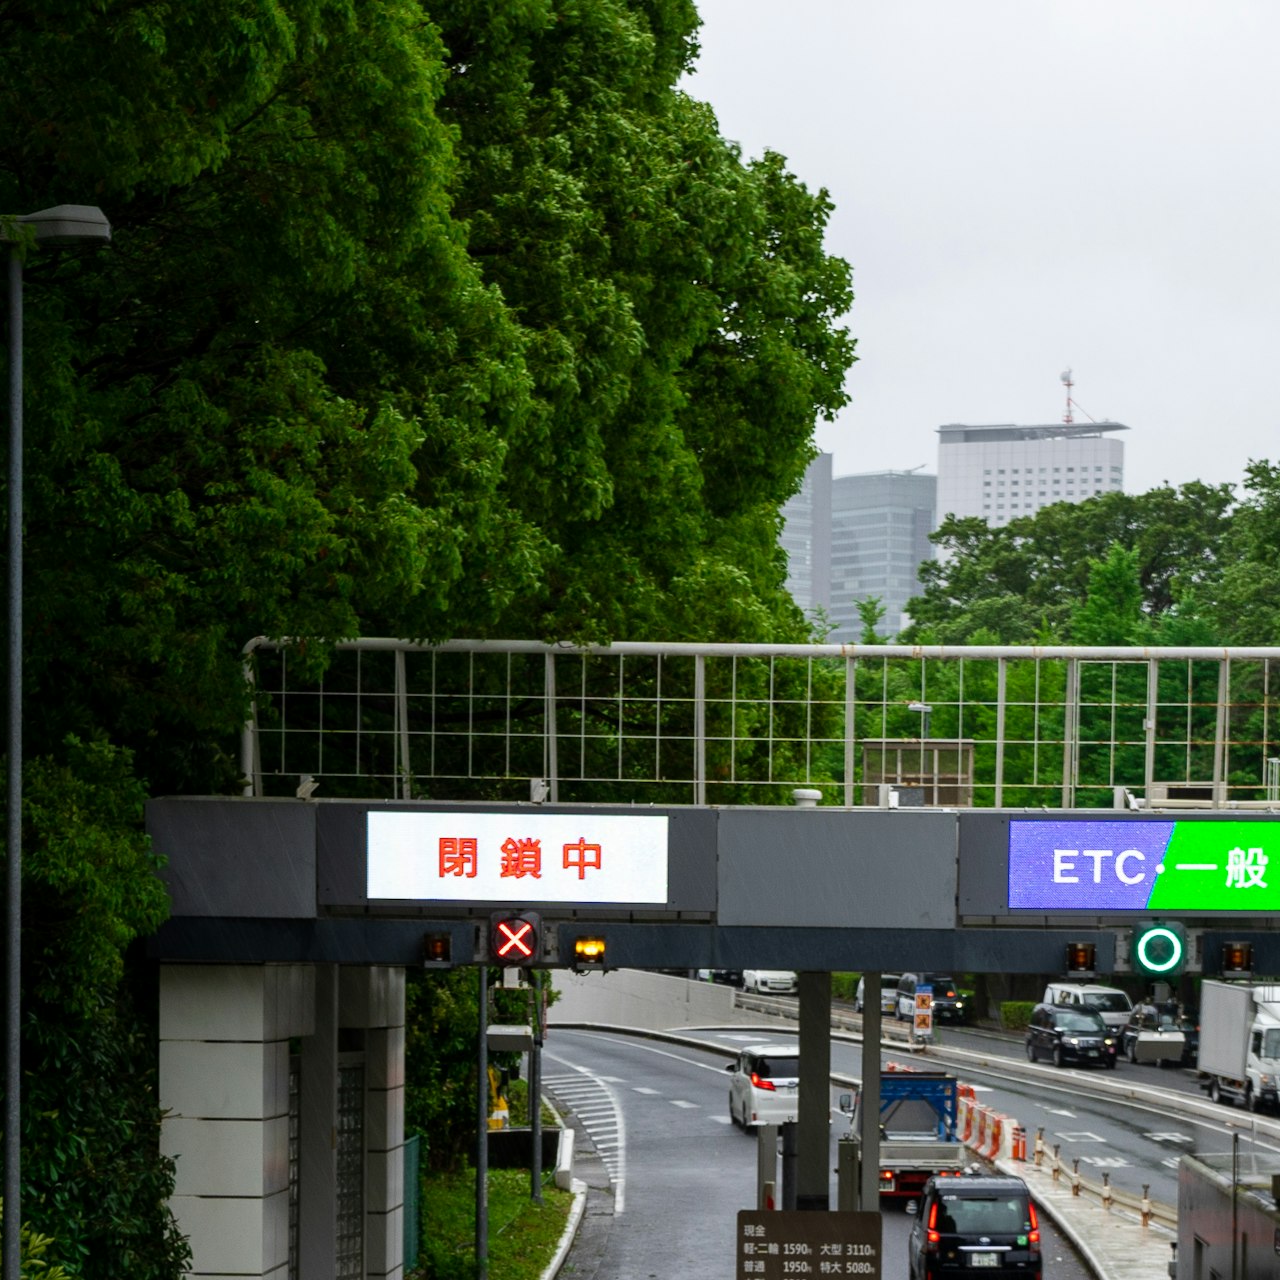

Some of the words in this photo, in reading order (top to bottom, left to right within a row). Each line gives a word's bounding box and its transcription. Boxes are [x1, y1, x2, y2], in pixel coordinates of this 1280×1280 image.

[438, 837, 602, 880] 閉鎖中
[744, 1224, 766, 1237] 現金
[820, 1243, 842, 1256] 大型
[743, 1260, 766, 1273] 普通
[820, 1261, 842, 1274] 特大
